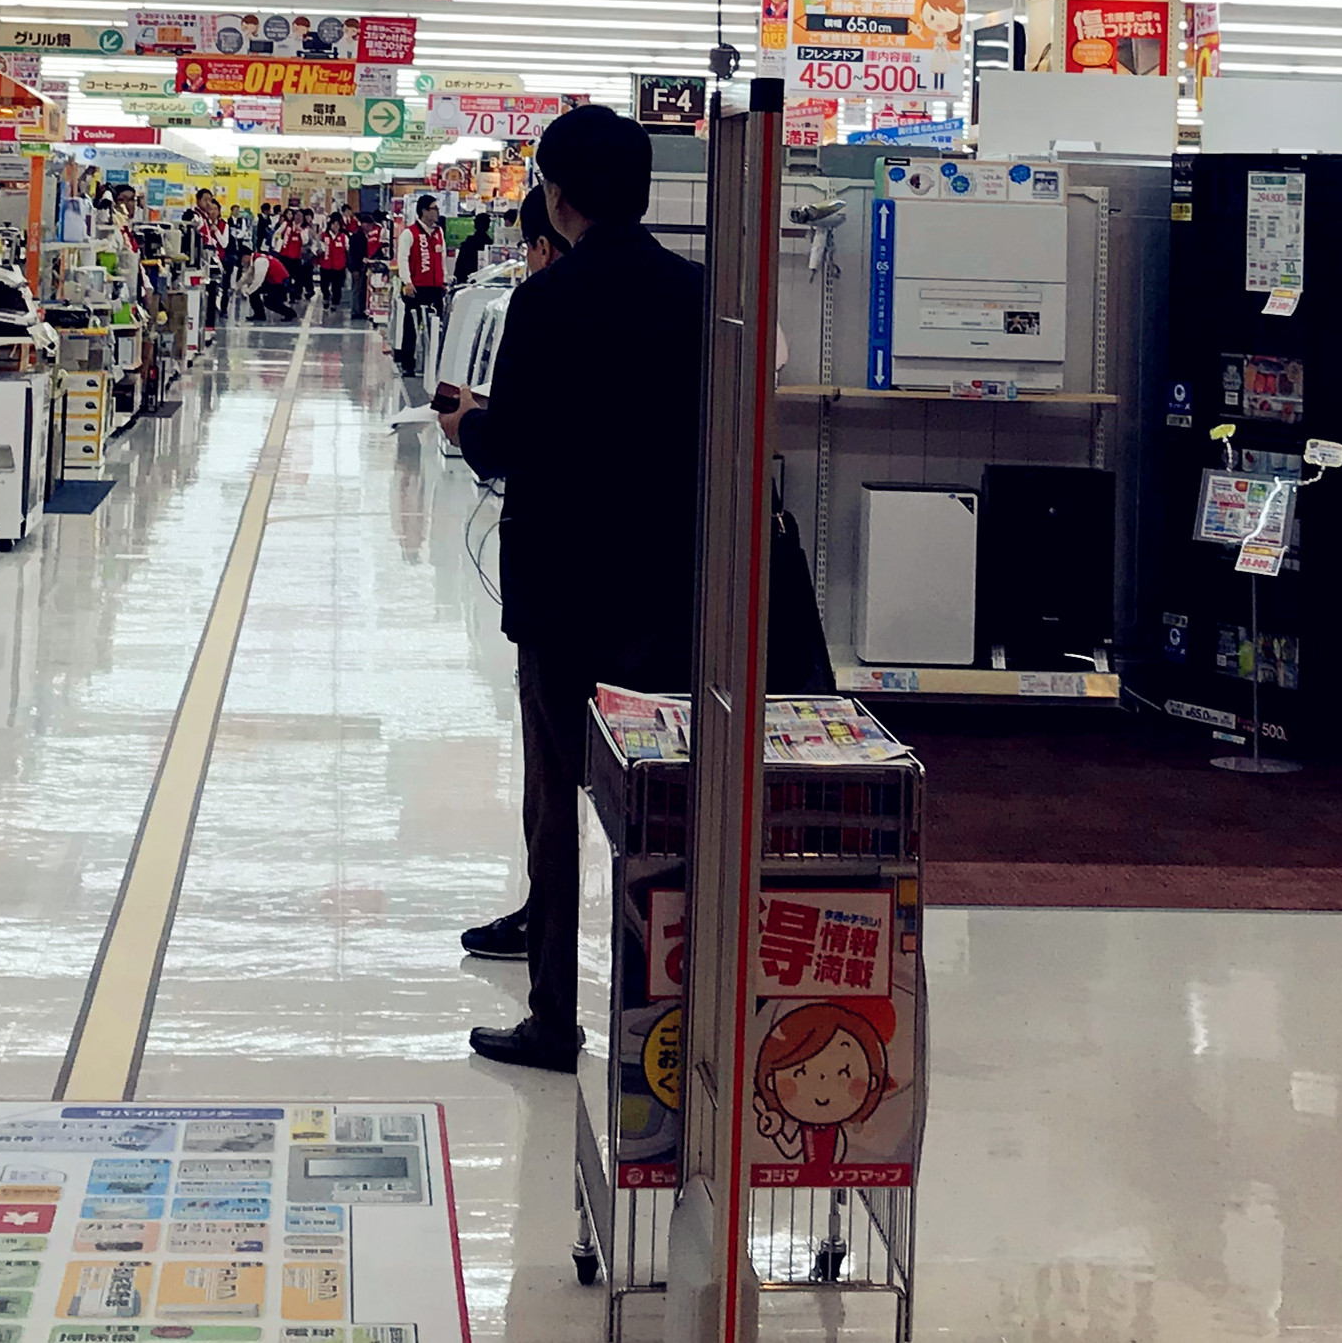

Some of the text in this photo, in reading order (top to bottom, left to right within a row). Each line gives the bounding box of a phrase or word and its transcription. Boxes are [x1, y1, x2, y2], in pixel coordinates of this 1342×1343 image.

[846, 16, 892, 33] 65.0cm
[1105, 22, 1162, 37] つけない
[14, 31, 71, 47] グリル鍋
[806, 49, 861, 60] フレンチドア
[244, 63, 318, 94] OPEN
[317, 67, 352, 82] セール
[86, 80, 157, 90] コーヒーメーカー
[445, 80, 513, 90] ロボットクリーナー
[653, 88, 692, 112] F-4
[313, 103, 336, 115] 電球
[301, 115, 346, 127] 防災用品
[83, 130, 116, 139] Cashier
[786, 131, 819, 145] 満足
[310, 156, 352, 164] デジタルカメラ
[418, 234, 430, 273] KOJIMA
[820, 922, 879, 958] 情報
[814, 953, 875, 989] 満載
[758, 1168, 902, 1184] コジマ ソフマップ
